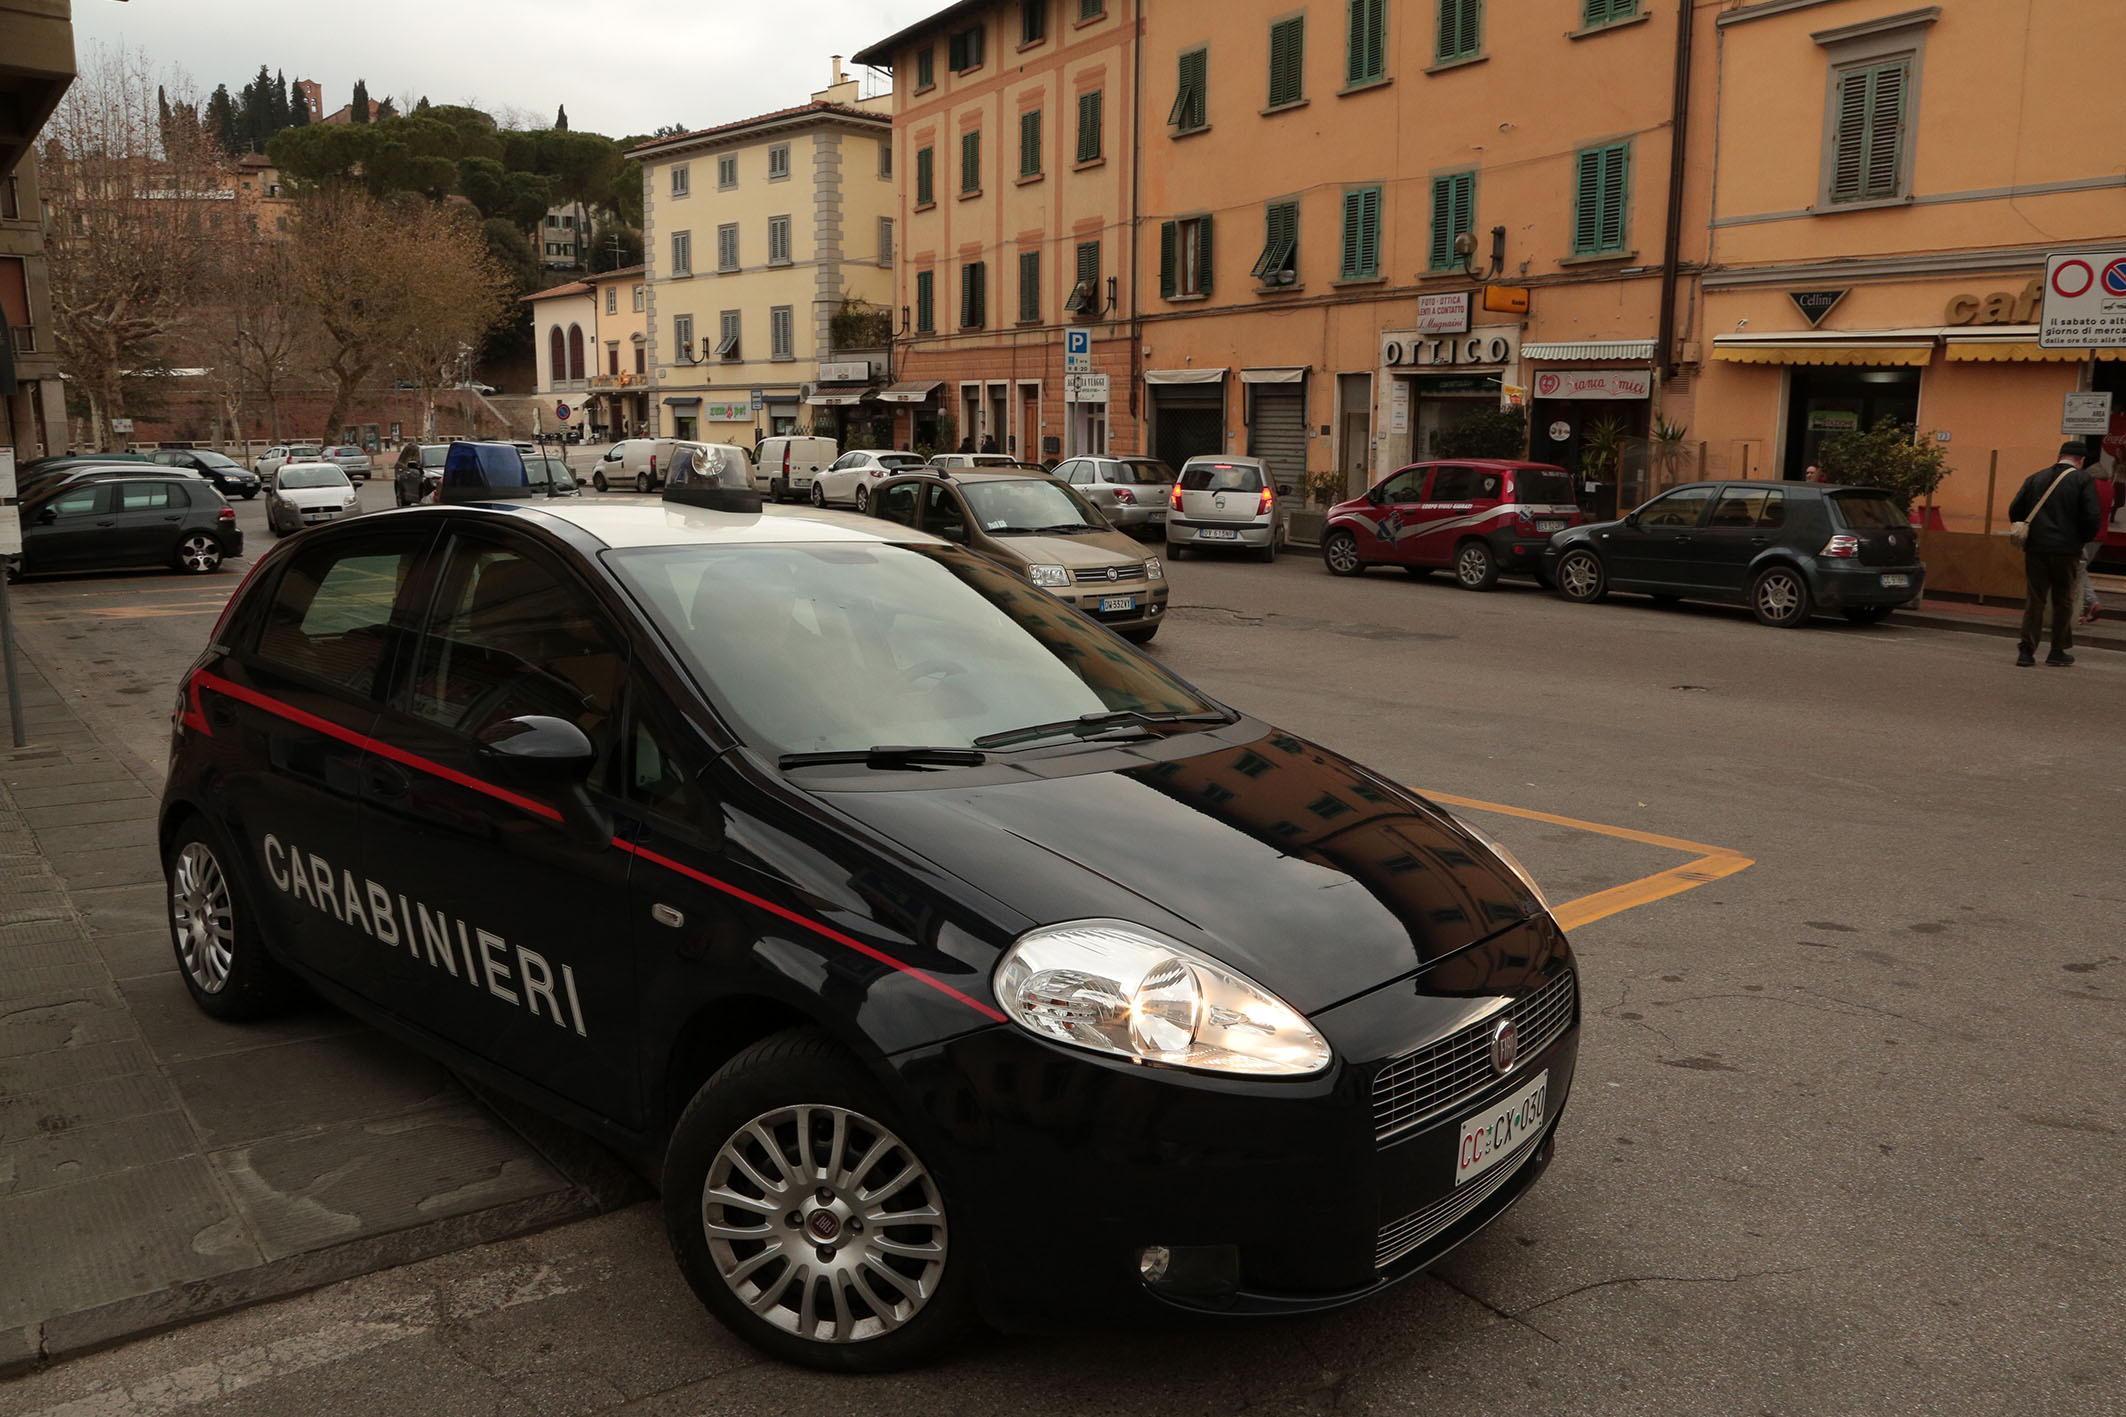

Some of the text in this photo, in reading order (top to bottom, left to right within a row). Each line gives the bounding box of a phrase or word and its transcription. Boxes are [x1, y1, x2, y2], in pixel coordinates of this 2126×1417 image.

[1439, 296, 1461, 305] OTTICA
[1800, 293, 1832, 306] Cellini
[1436, 305, 1464, 315] CONTATTO
[2061, 317, 2096, 325] sabato
[2109, 316, 2126, 325] alt
[2045, 327, 2079, 336] giorno
[2082, 326, 2092, 335] di
[1072, 334, 1084, 351] P
[1384, 337, 1508, 366] OTTICO
[263, 833, 587, 1038] CARABINIERI
